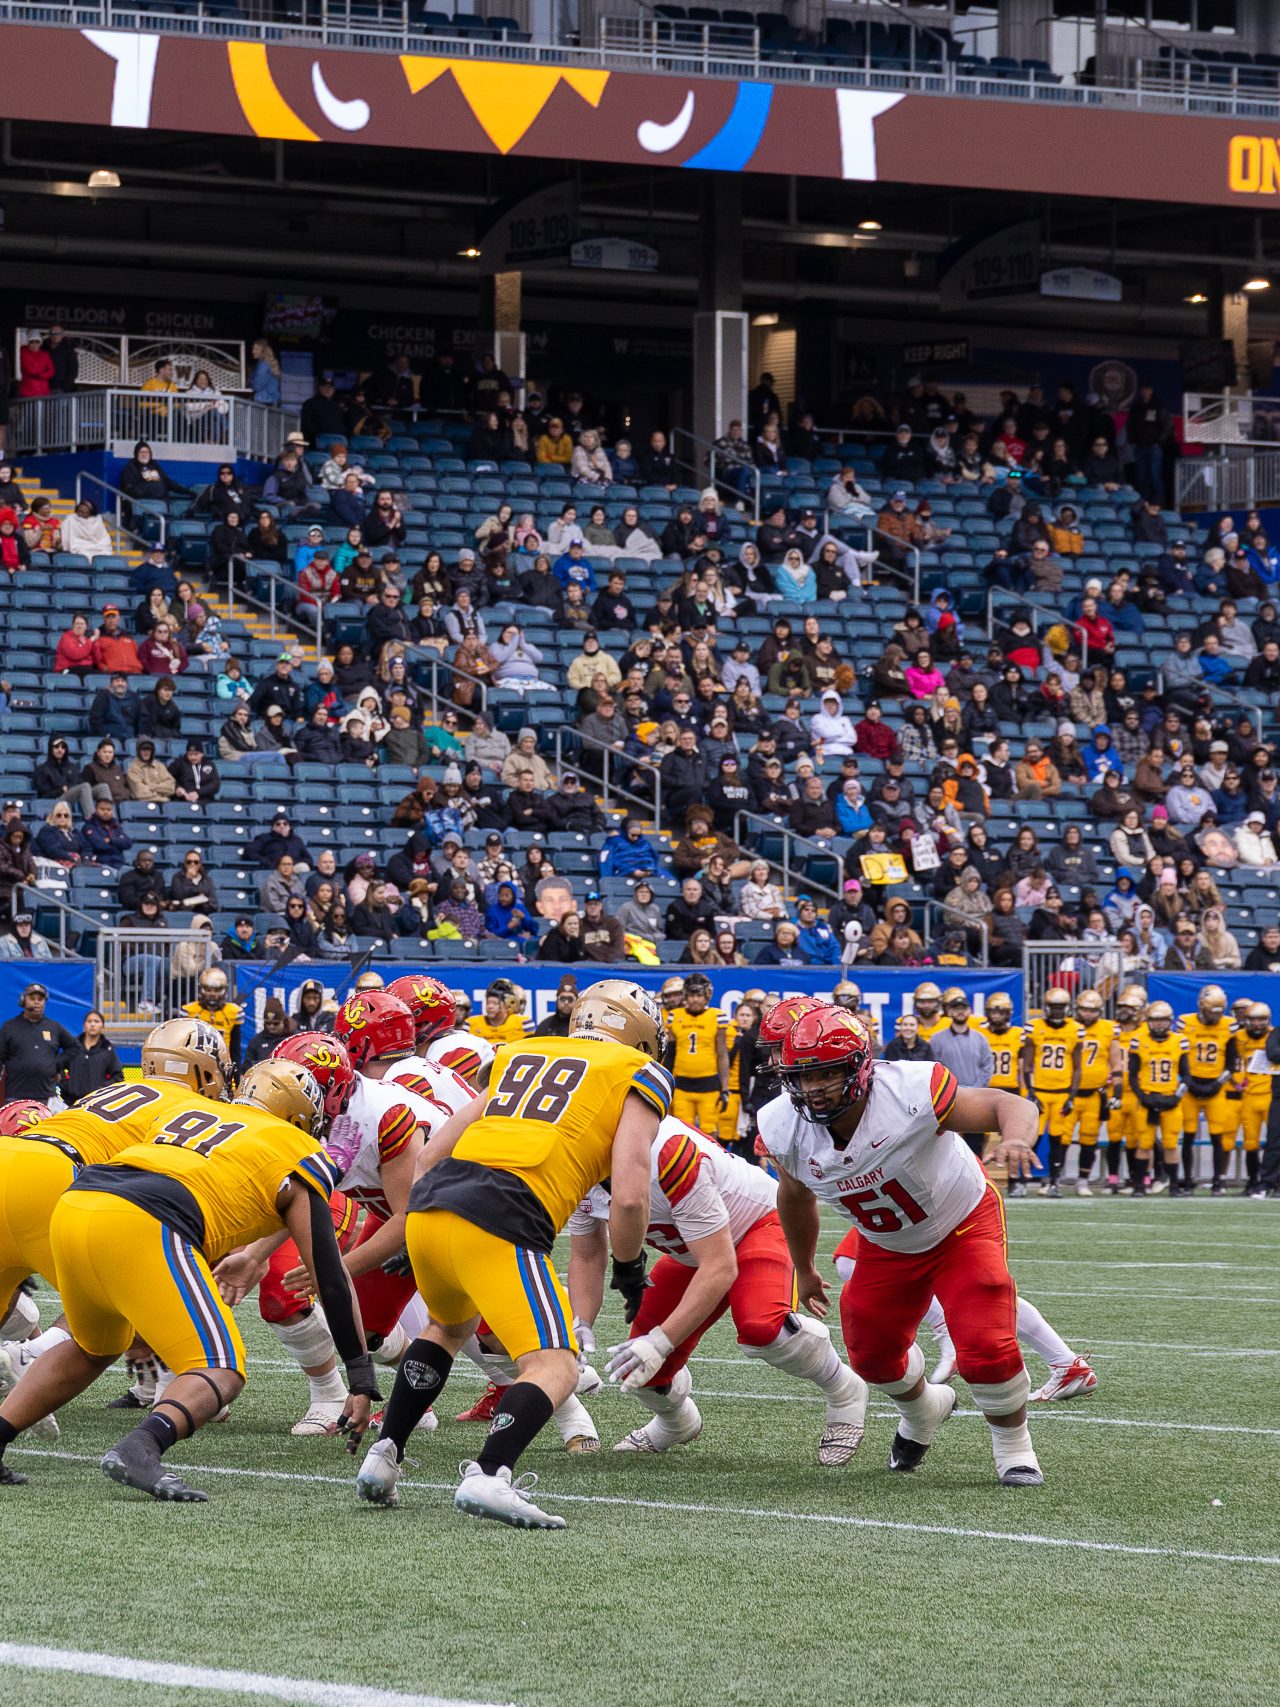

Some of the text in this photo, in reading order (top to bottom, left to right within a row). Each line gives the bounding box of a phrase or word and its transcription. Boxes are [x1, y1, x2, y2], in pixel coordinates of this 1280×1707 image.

[509, 214, 568, 249] 108-109
[628, 248, 648, 264] 109
[24, 305, 109, 325] EXCELDOR
[145, 311, 215, 329] CHICKEN
[367, 324, 436, 342] CHICKEN
[386, 341, 436, 358] STAND
[904, 343, 967, 363] KEEP RIGHT
[688, 1032, 698, 1054] 1
[1195, 1042, 1218, 1064] 12
[1041, 1043, 1066, 1069] 26
[1150, 1059, 1172, 1083] 19
[485, 1054, 589, 1124] 98
[153, 1109, 248, 1159] 91
[836, 1166, 885, 1193] CALGARY
[838, 1177, 929, 1234] 61
